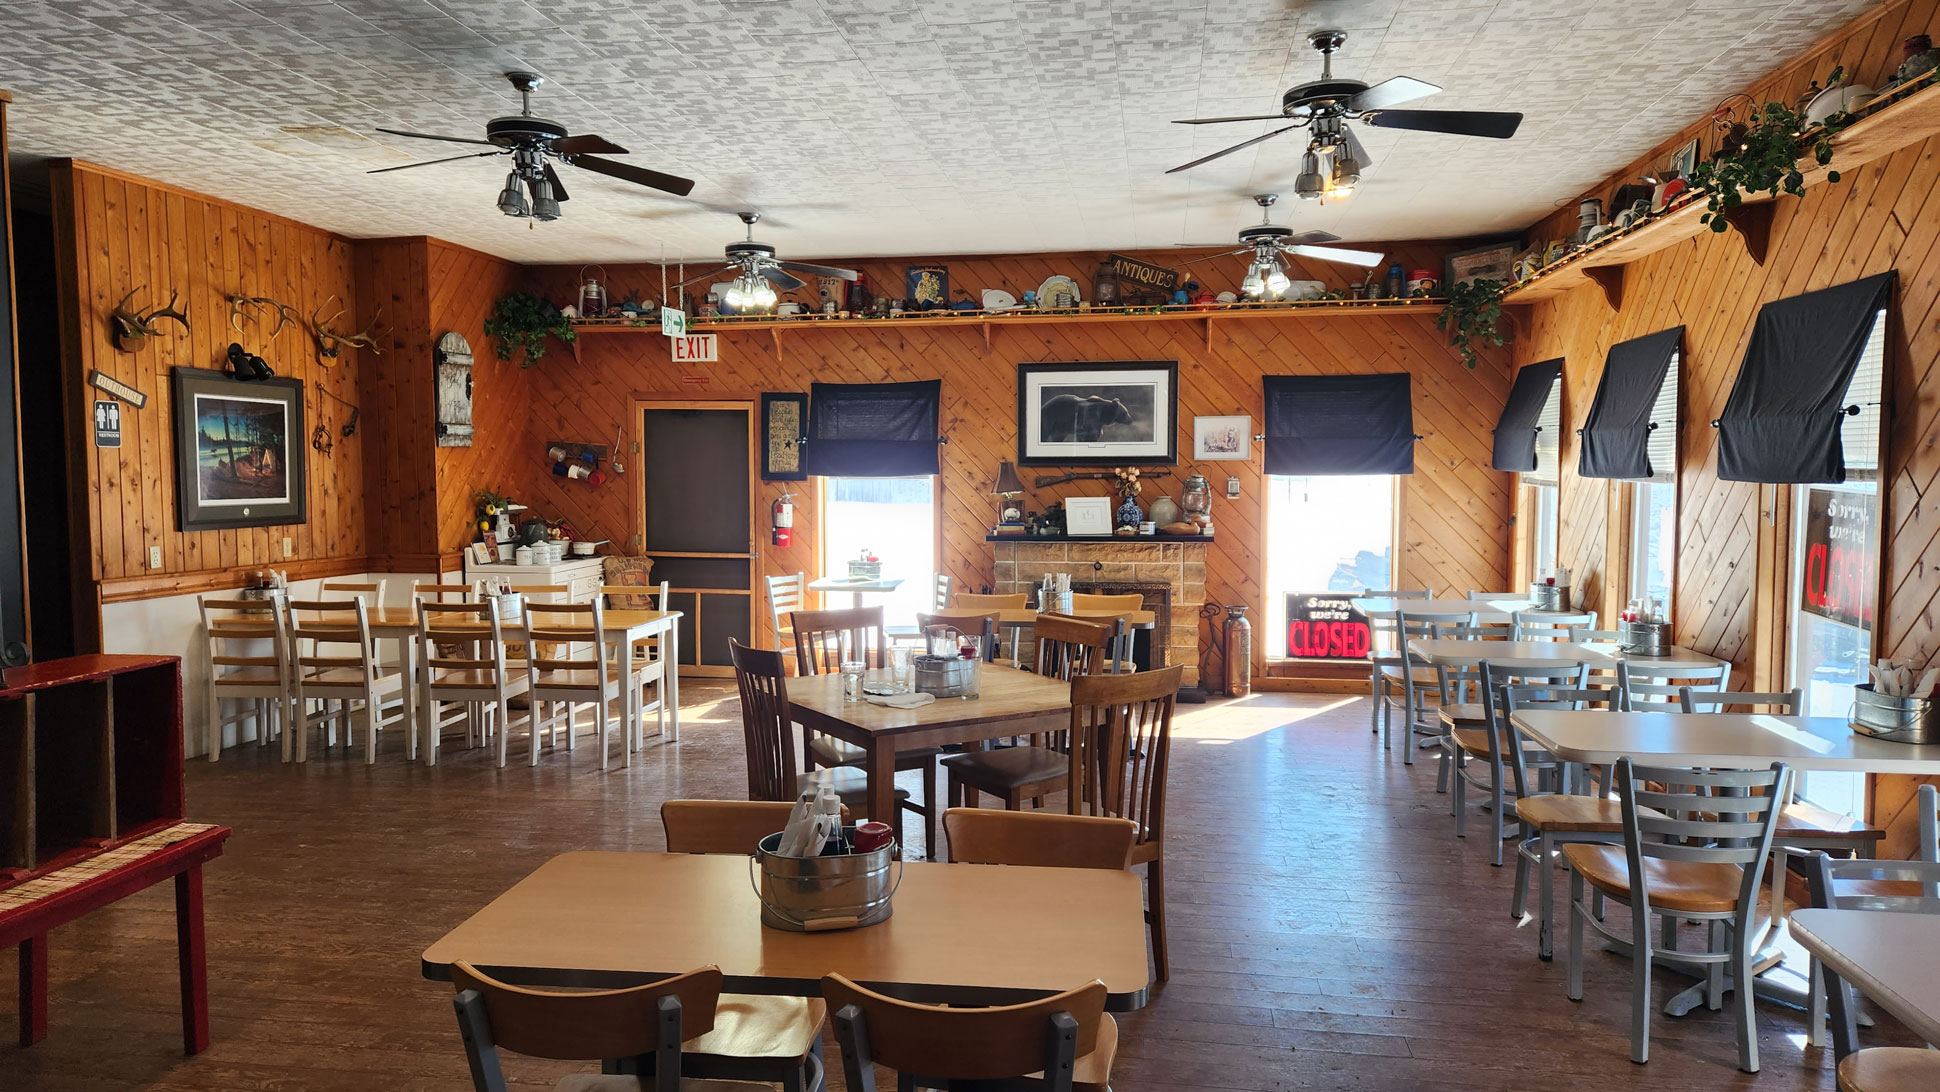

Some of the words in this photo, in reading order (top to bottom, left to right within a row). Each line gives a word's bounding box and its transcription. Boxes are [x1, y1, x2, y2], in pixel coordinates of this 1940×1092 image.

[1113, 260, 1174, 288] ANTIQUES
[676, 337, 709, 359] EXIT
[99, 377, 140, 402] OUTHOUSE
[1307, 597, 1352, 610] Sorry,
[1310, 609, 1350, 620] we're
[1289, 621, 1370, 658] CLOSED
